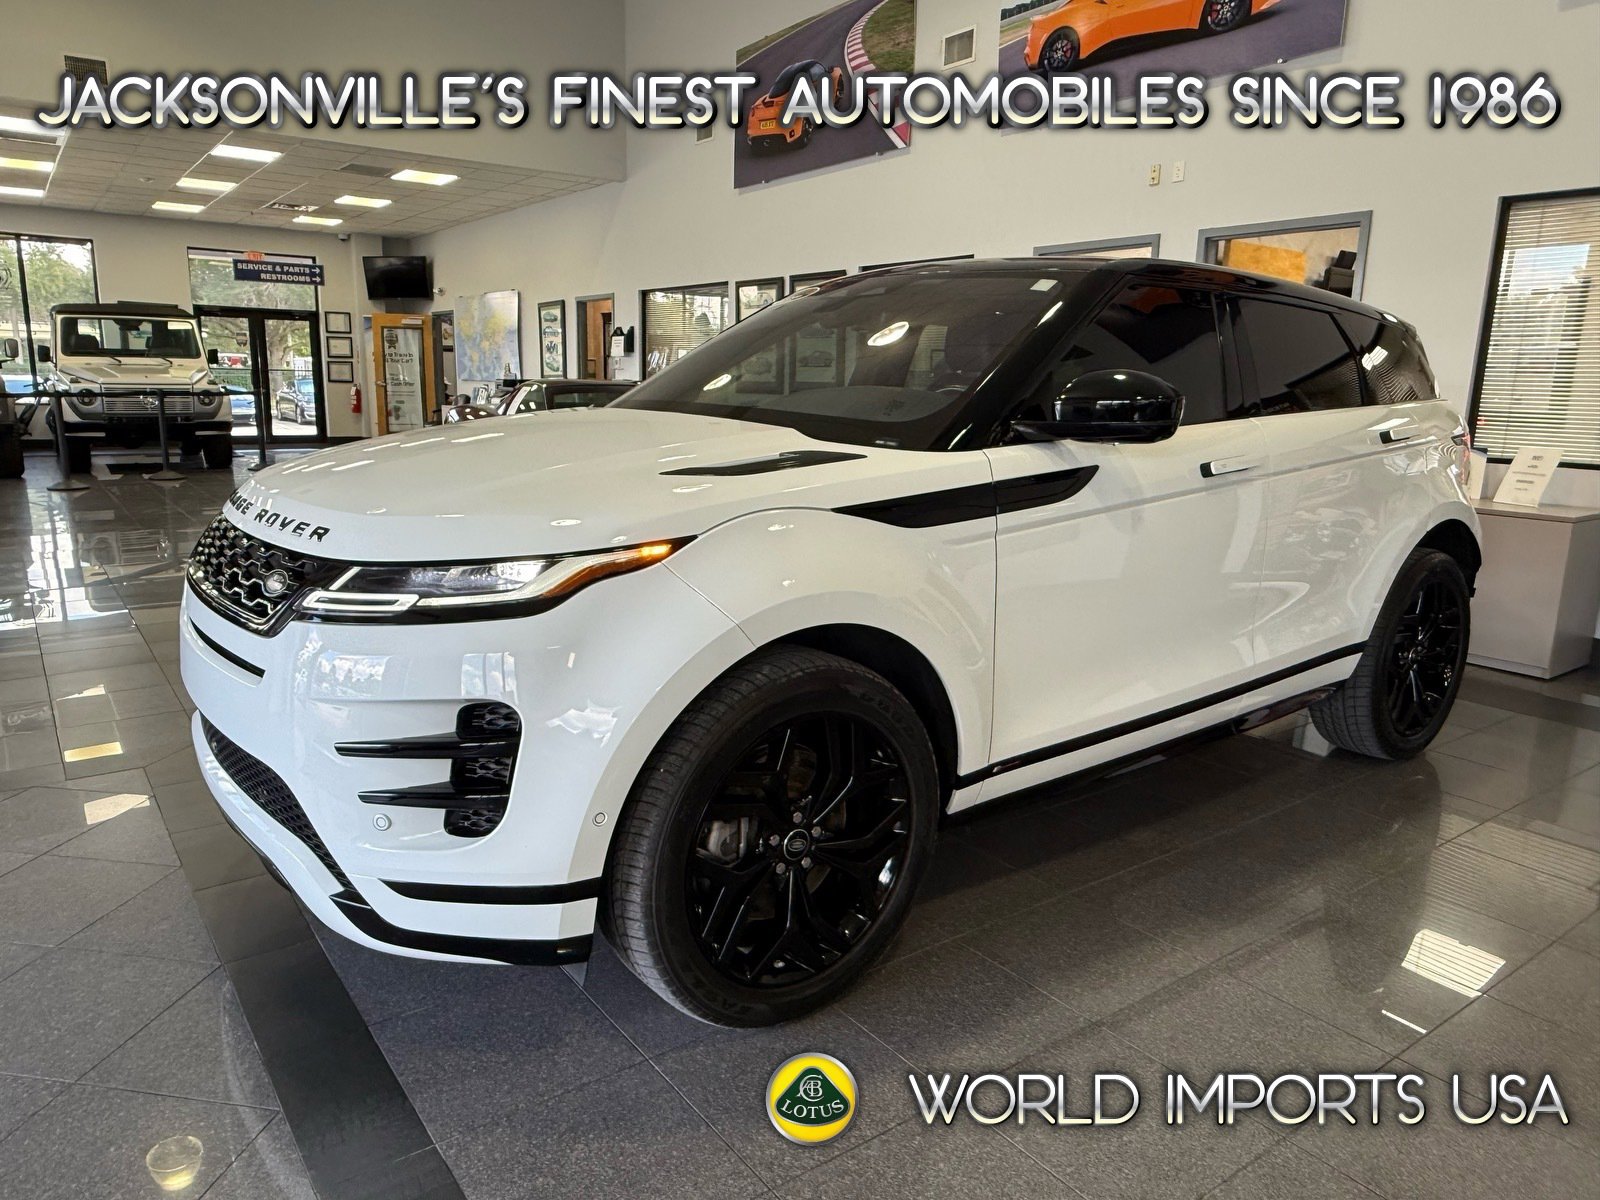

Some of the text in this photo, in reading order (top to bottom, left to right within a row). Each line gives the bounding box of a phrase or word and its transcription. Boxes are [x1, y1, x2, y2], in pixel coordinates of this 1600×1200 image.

[237, 262, 273, 271] SERVICE
[283, 265, 310, 274] PARTS
[260, 272, 311, 282] RESTROOMS
[253, 508, 331, 543] ROVER
